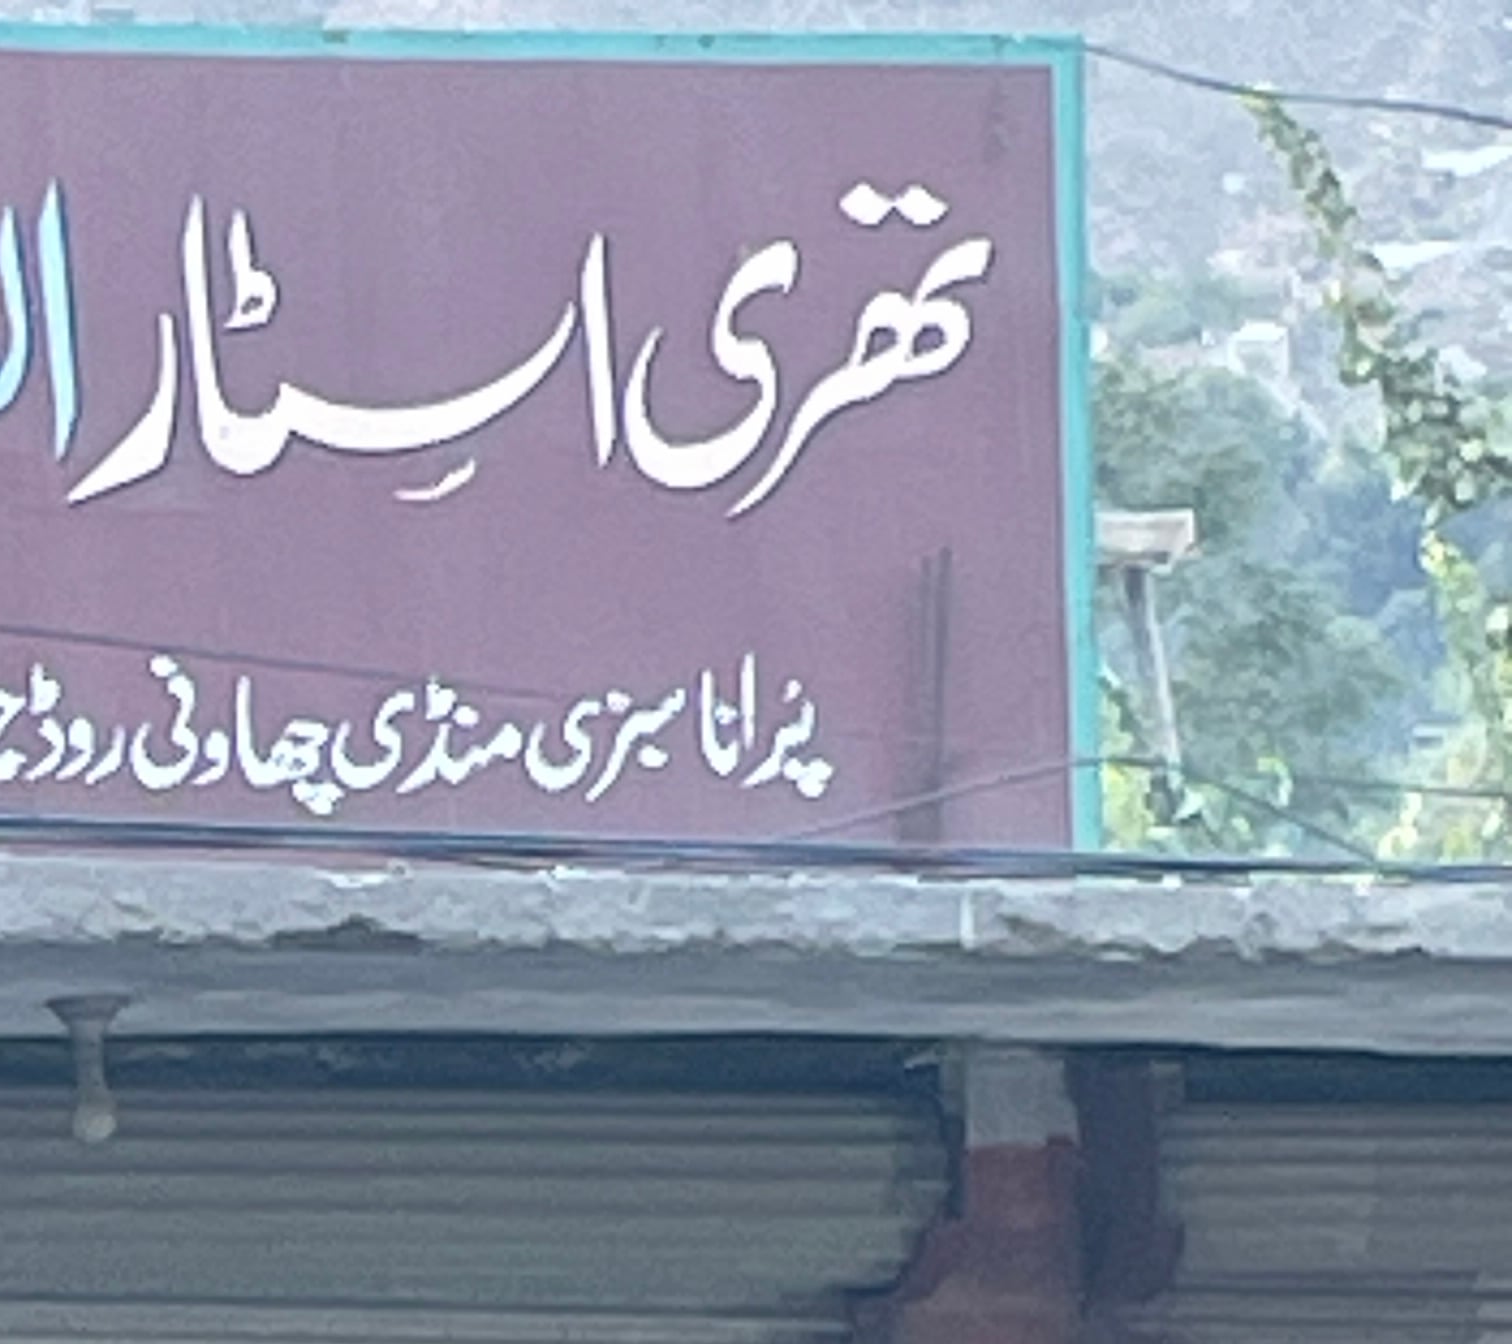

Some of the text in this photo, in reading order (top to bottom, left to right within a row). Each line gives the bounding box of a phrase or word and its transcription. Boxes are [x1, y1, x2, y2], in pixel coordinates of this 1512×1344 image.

[624, 182, 993, 515] تھری
[25, 663, 125, 785] روڈ
[331, 674, 523, 794] منڈی
[524, 688, 686, 802] سبزی
